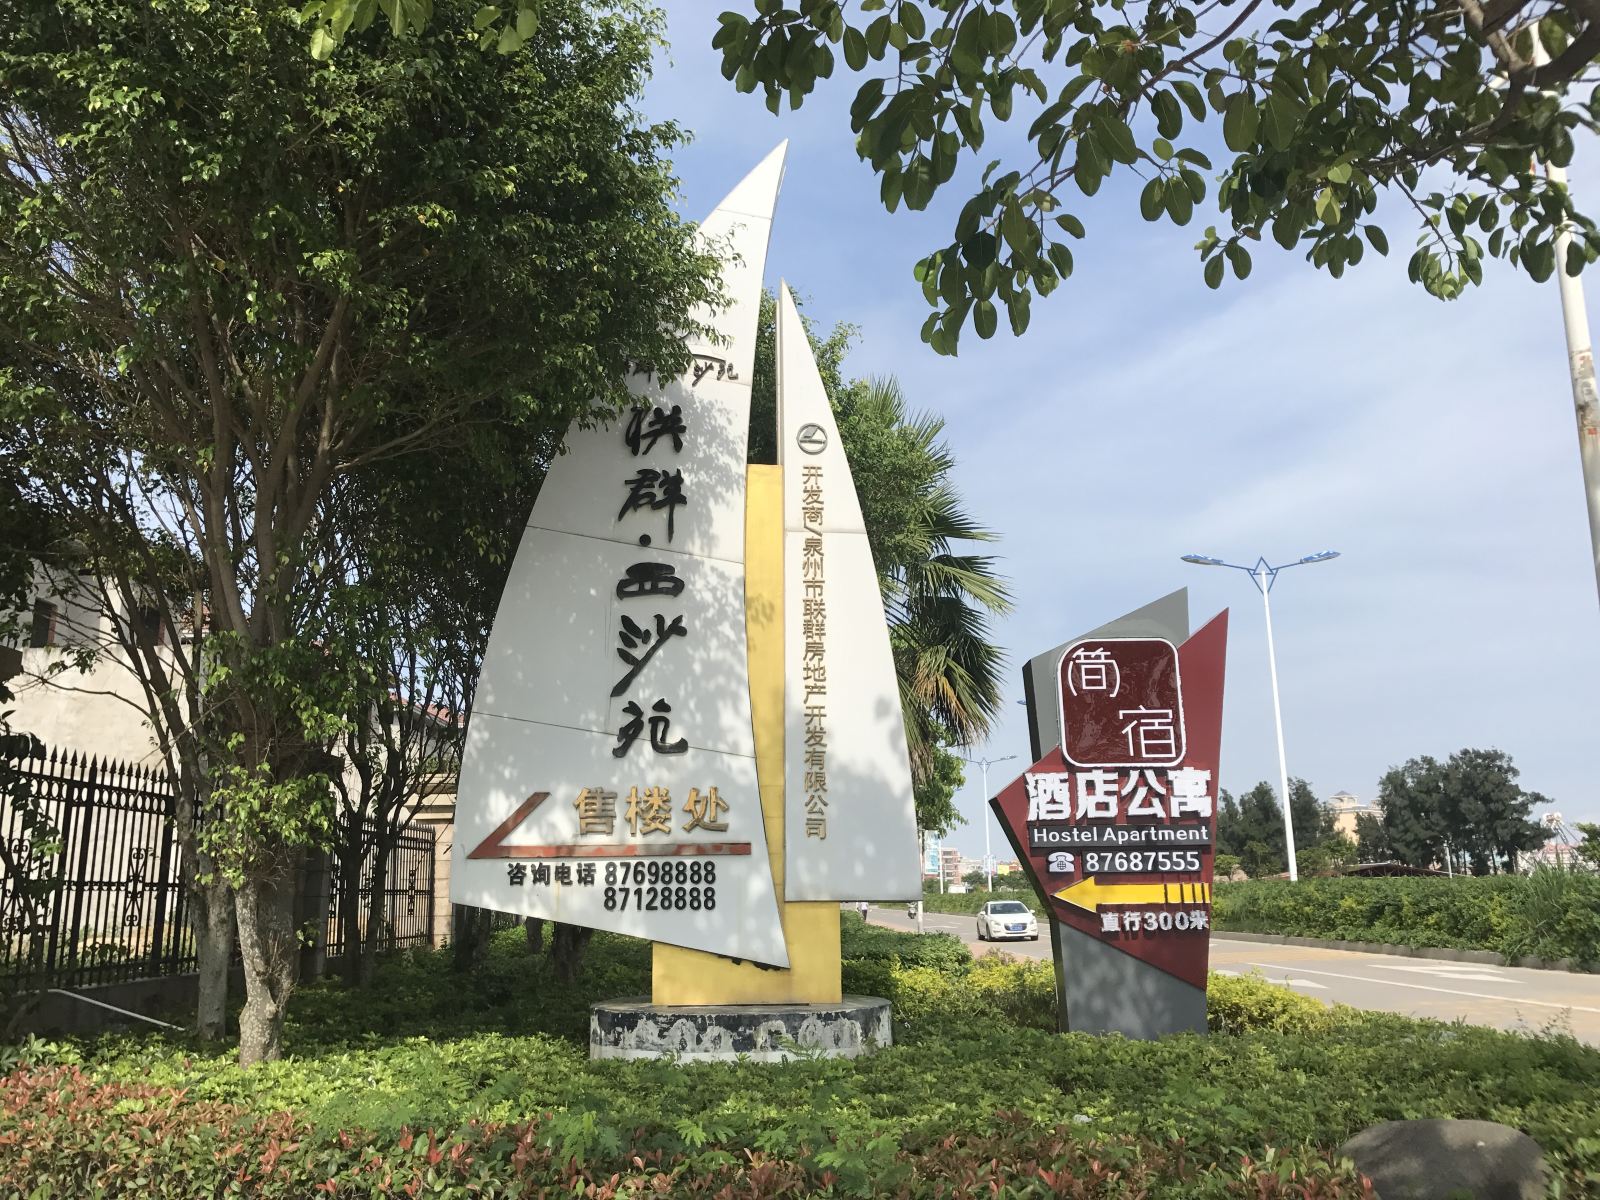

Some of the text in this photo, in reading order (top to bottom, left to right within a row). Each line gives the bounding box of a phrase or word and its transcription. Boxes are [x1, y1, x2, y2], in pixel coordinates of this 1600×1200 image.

[1025, 767, 1212, 821] 酒店公寓
[573, 786, 729, 837] 售楼处
[1033, 825, 1209, 847] Hostel Apartment
[507, 860, 716, 886] 咨询电话 87698888
[1086, 850, 1200, 872] 87687555
[603, 886, 716, 911] 87128888
[1101, 910, 1209, 933] 直行300米
